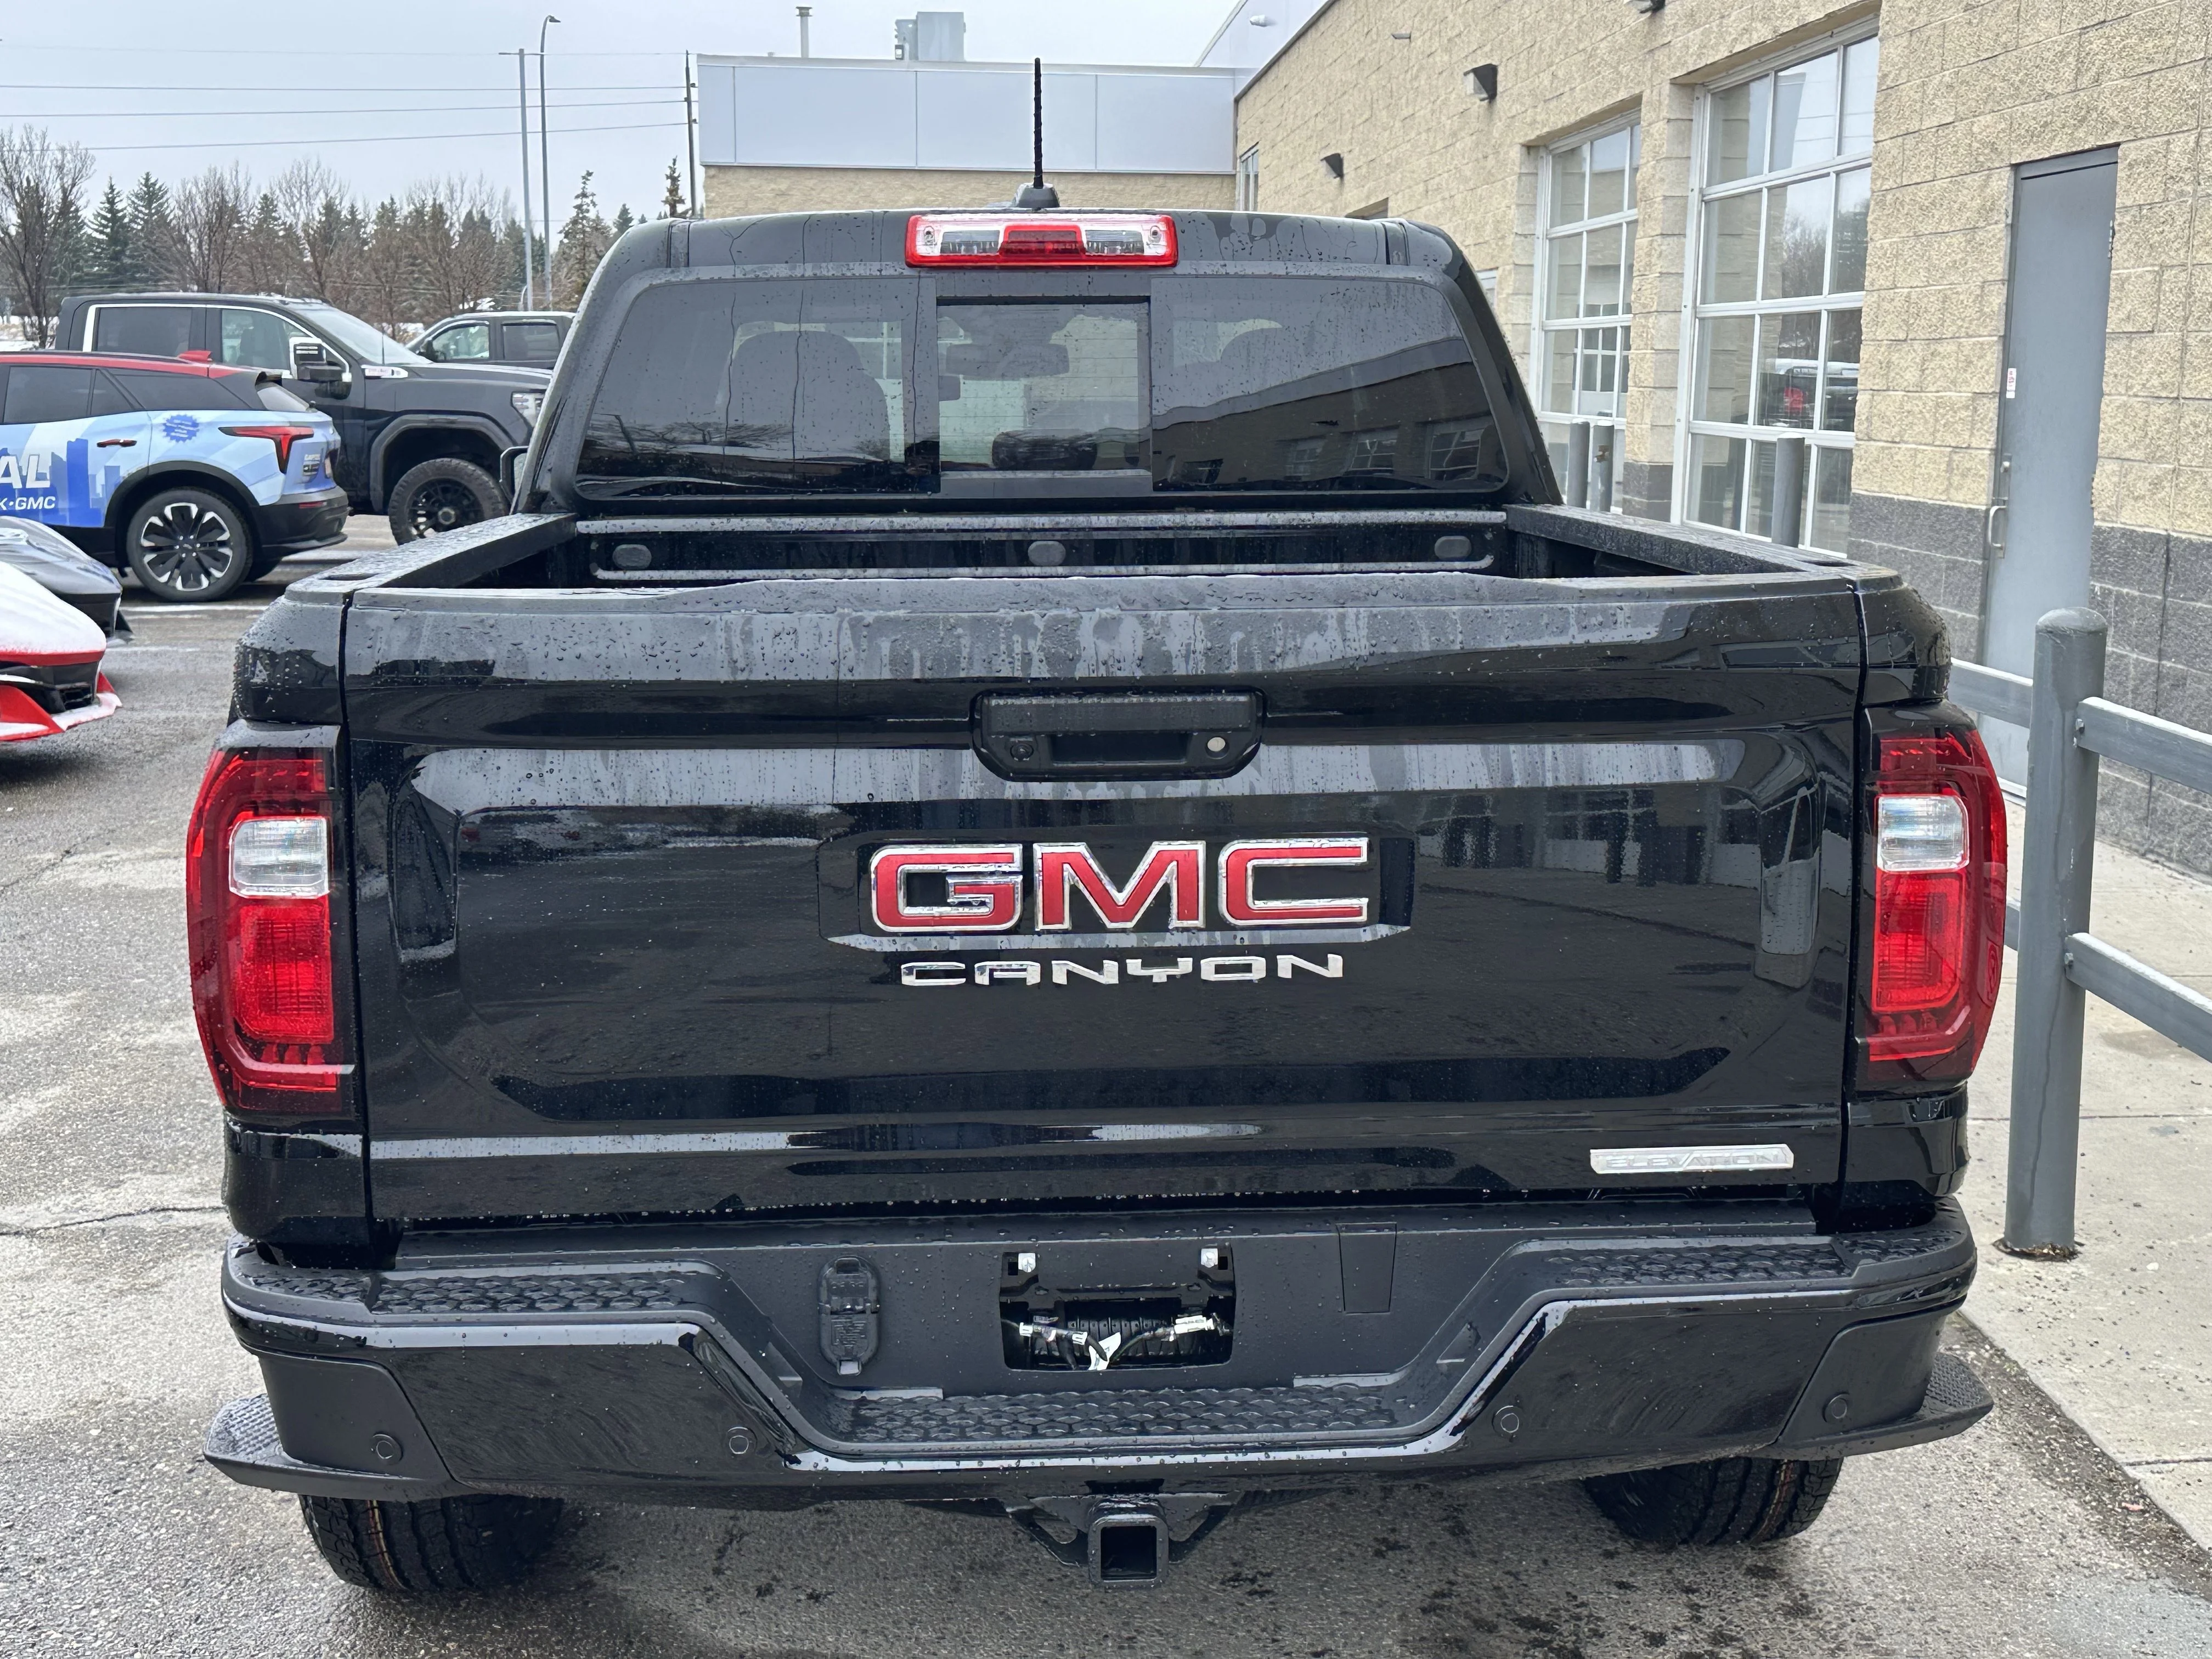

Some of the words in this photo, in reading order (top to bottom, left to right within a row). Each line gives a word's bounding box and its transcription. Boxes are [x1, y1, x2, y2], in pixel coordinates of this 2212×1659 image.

[870, 837, 1369, 933] GMC
[900, 953, 1344, 986] CANYON
[1603, 1149, 1782, 1169] ELEVATION
